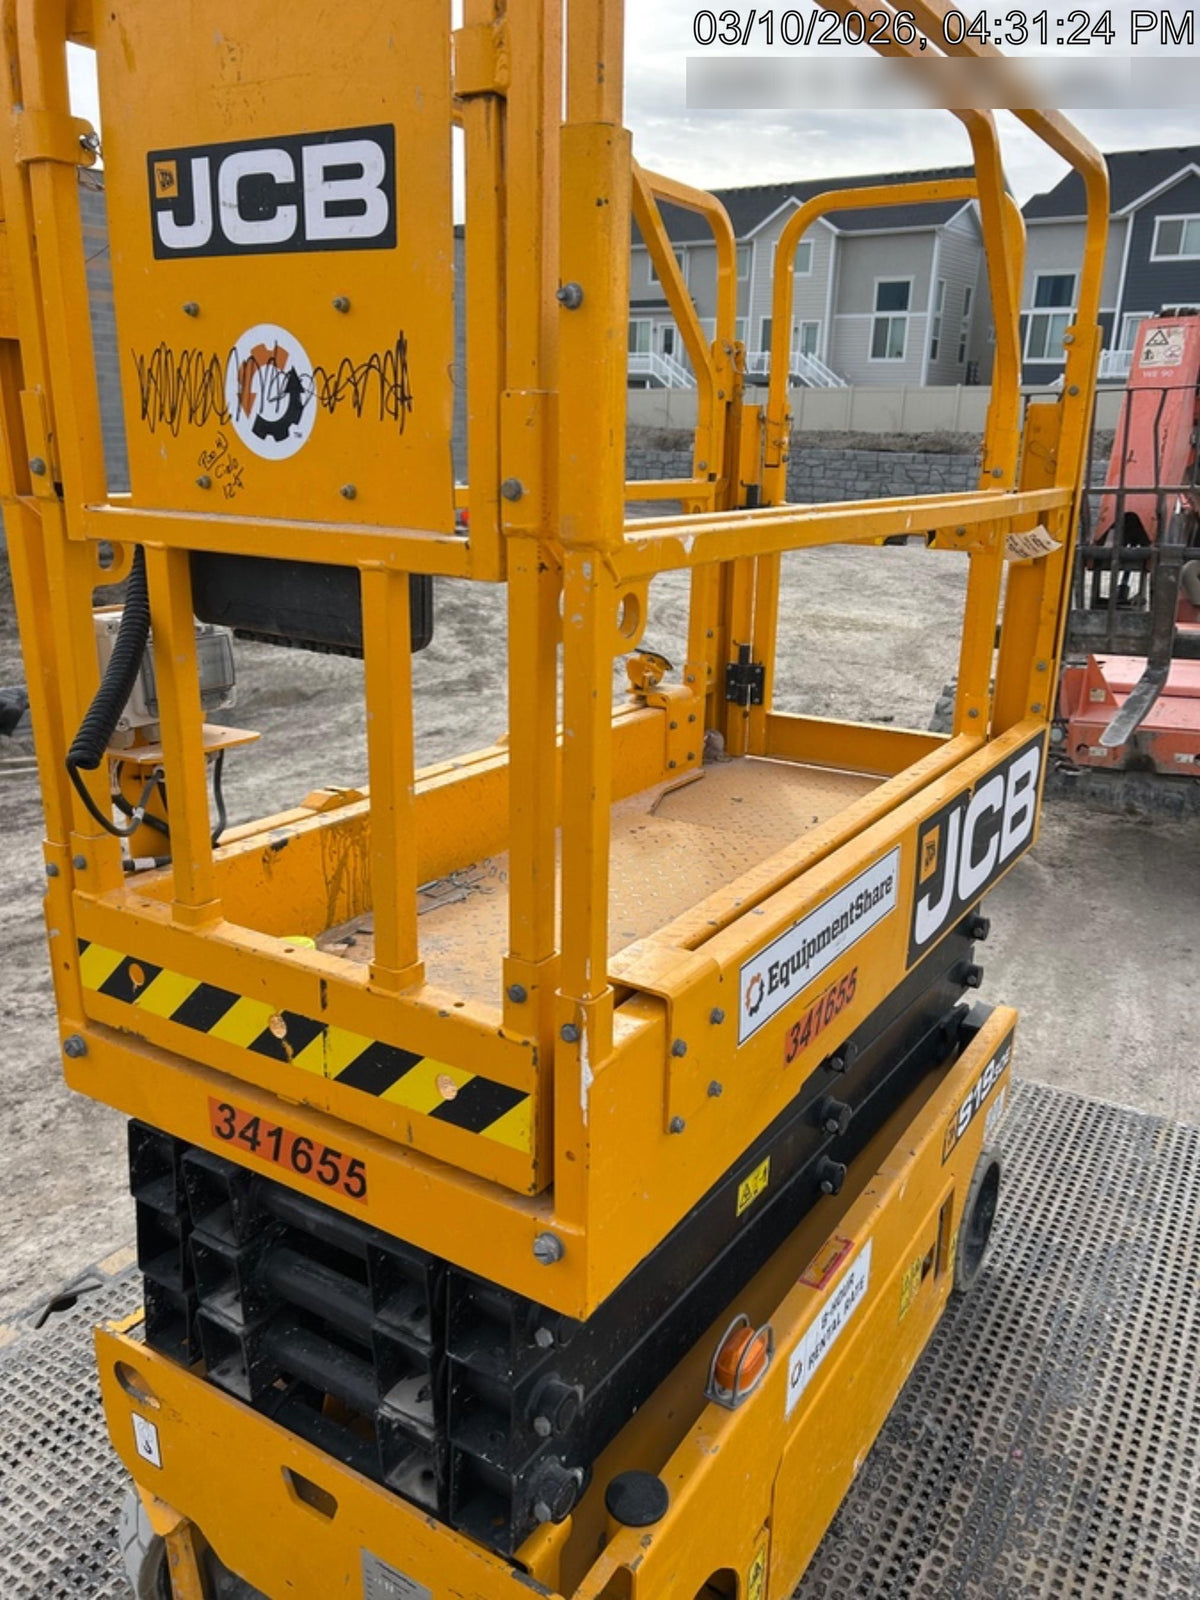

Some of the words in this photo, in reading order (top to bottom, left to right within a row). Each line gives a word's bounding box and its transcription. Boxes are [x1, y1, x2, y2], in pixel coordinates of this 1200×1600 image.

[156, 139, 390, 250] JCB
[914, 745, 1040, 945] JCB
[767, 875, 894, 997] EquipmentShare
[785, 966, 859, 1064] 341655
[214, 1103, 368, 1199] 341655
[806, 1312, 842, 1371] RENTAL
[843, 1273, 866, 1317] RATE
